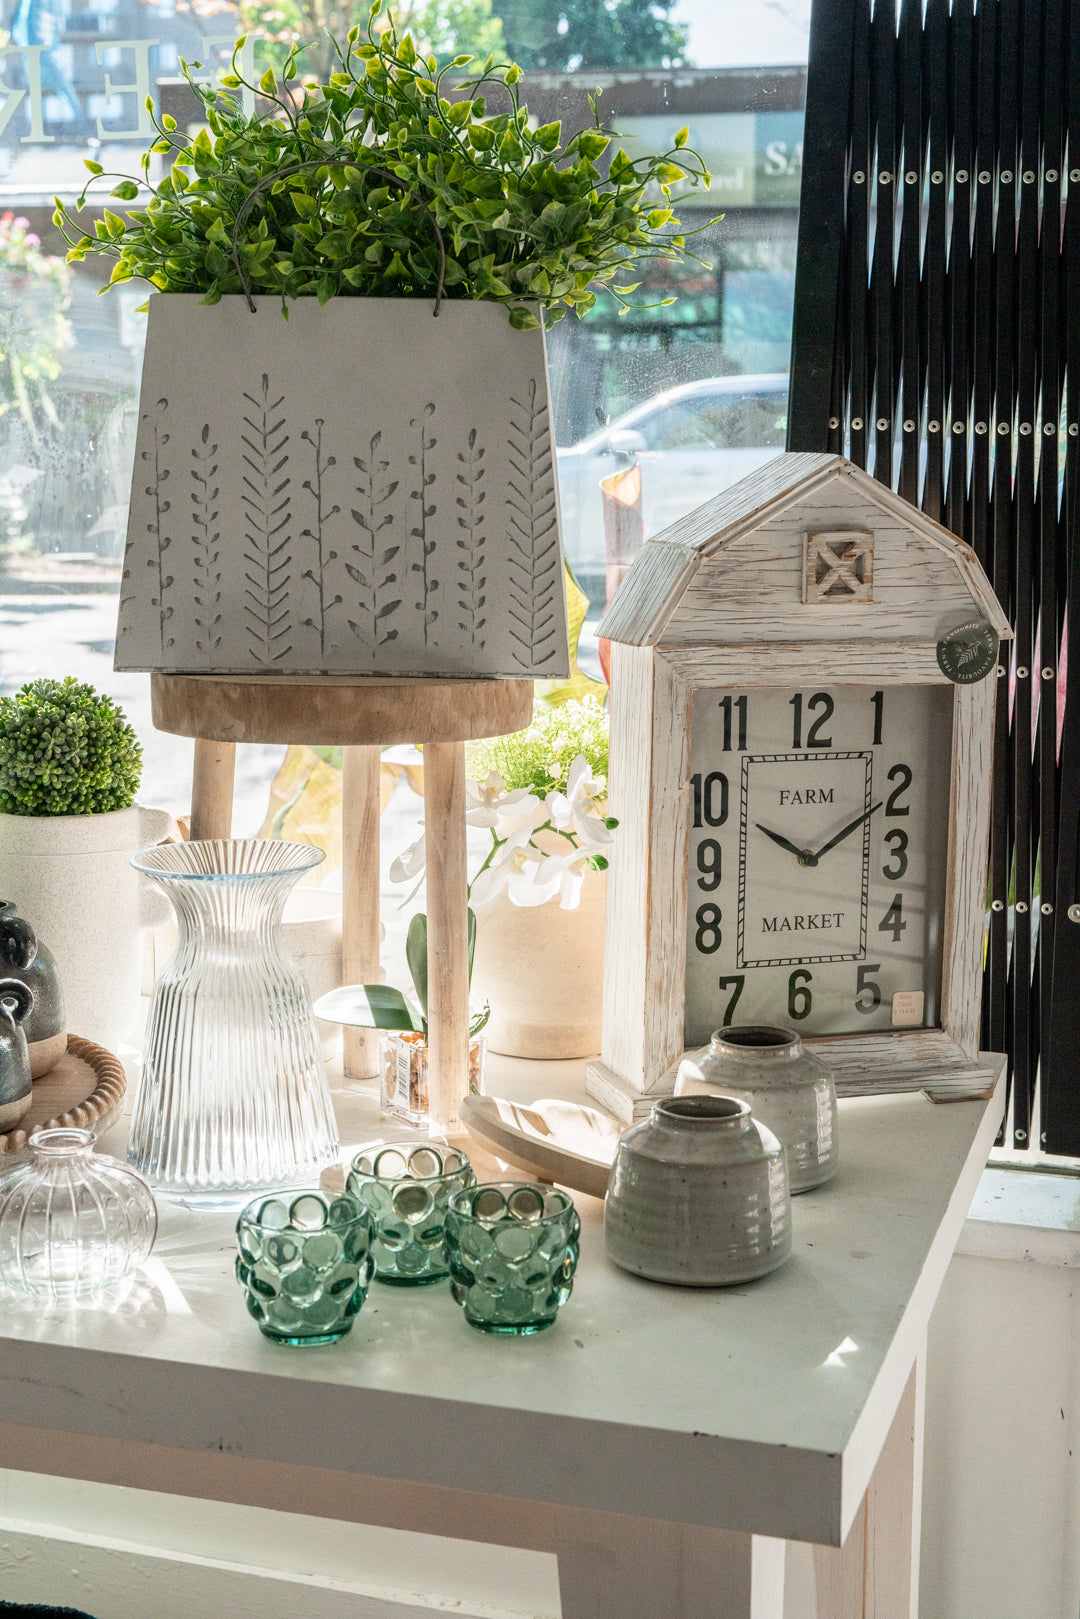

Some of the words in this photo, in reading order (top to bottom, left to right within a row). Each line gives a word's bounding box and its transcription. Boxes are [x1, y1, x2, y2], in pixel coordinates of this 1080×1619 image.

[718, 695, 748, 751] 11
[788, 692, 835, 749] 12
[870, 690, 884, 746] 1
[690, 771, 729, 829] 10
[778, 788, 835, 806] FARM
[884, 763, 913, 817] 2
[696, 838, 722, 892] 9
[882, 828, 909, 881] 3
[695, 902, 723, 955] 8
[761, 912, 845, 933] MARKET
[878, 892, 907, 943] 4
[718, 974, 746, 1026] 7
[787, 968, 813, 1021] 6
[854, 963, 882, 1015] 5
